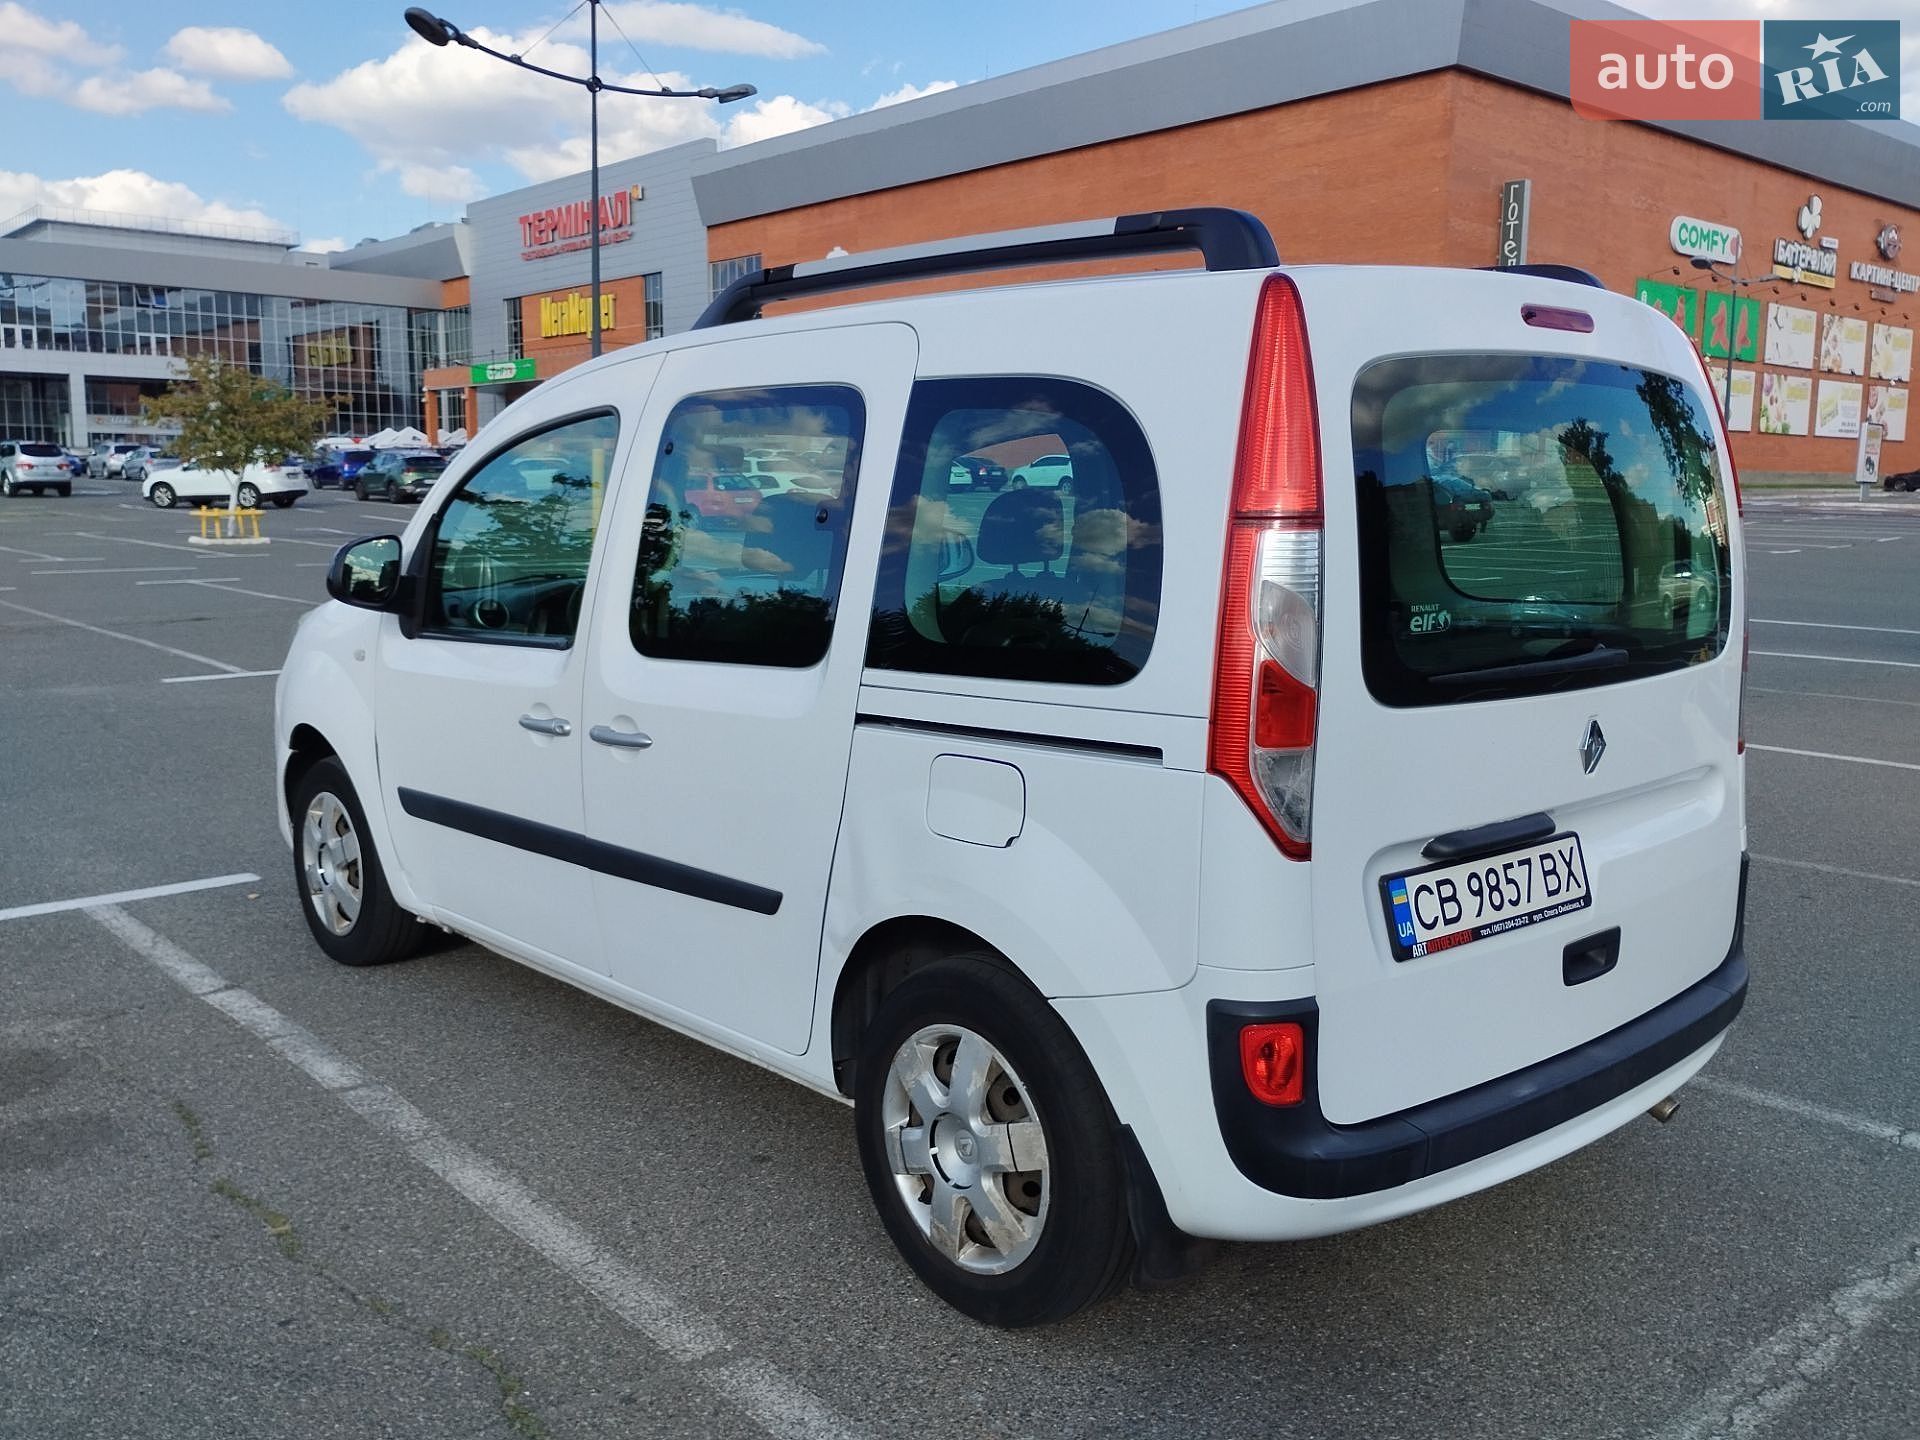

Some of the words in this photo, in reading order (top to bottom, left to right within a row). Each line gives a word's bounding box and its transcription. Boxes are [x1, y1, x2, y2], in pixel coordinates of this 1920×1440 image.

[519, 190, 632, 248] ТЕРМІНАЛ
[1678, 222, 1730, 255] COMFY
[540, 292, 615, 339] МегаМарет
[1414, 877, 1463, 930] CB
[1467, 857, 1532, 918] 9857
[1539, 846, 1581, 898] BX
[1398, 921, 1414, 938] UA
